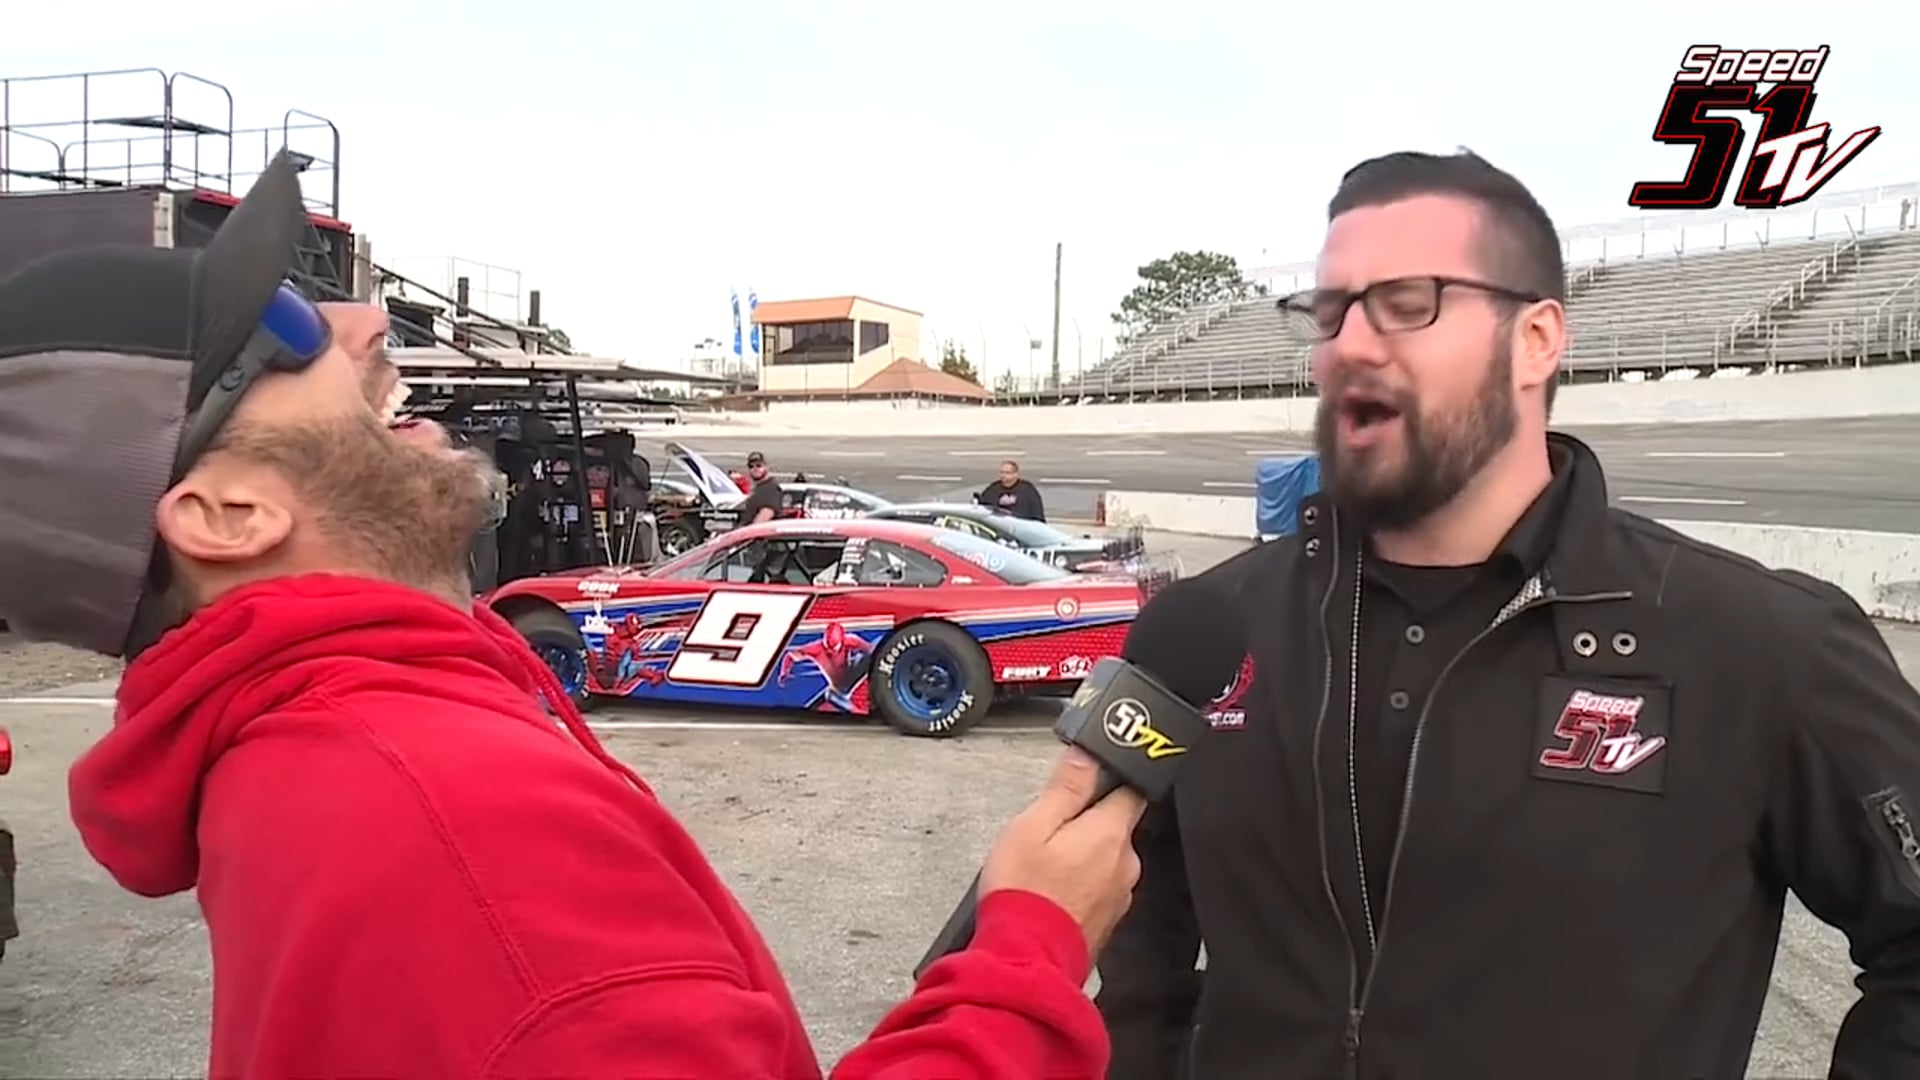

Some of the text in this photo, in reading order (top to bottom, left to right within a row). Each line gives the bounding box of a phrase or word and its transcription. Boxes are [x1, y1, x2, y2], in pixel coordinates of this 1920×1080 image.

[665, 588, 818, 688] 9
[876, 633, 925, 676] Hoosier
[1568, 689, 1645, 716] Speed
